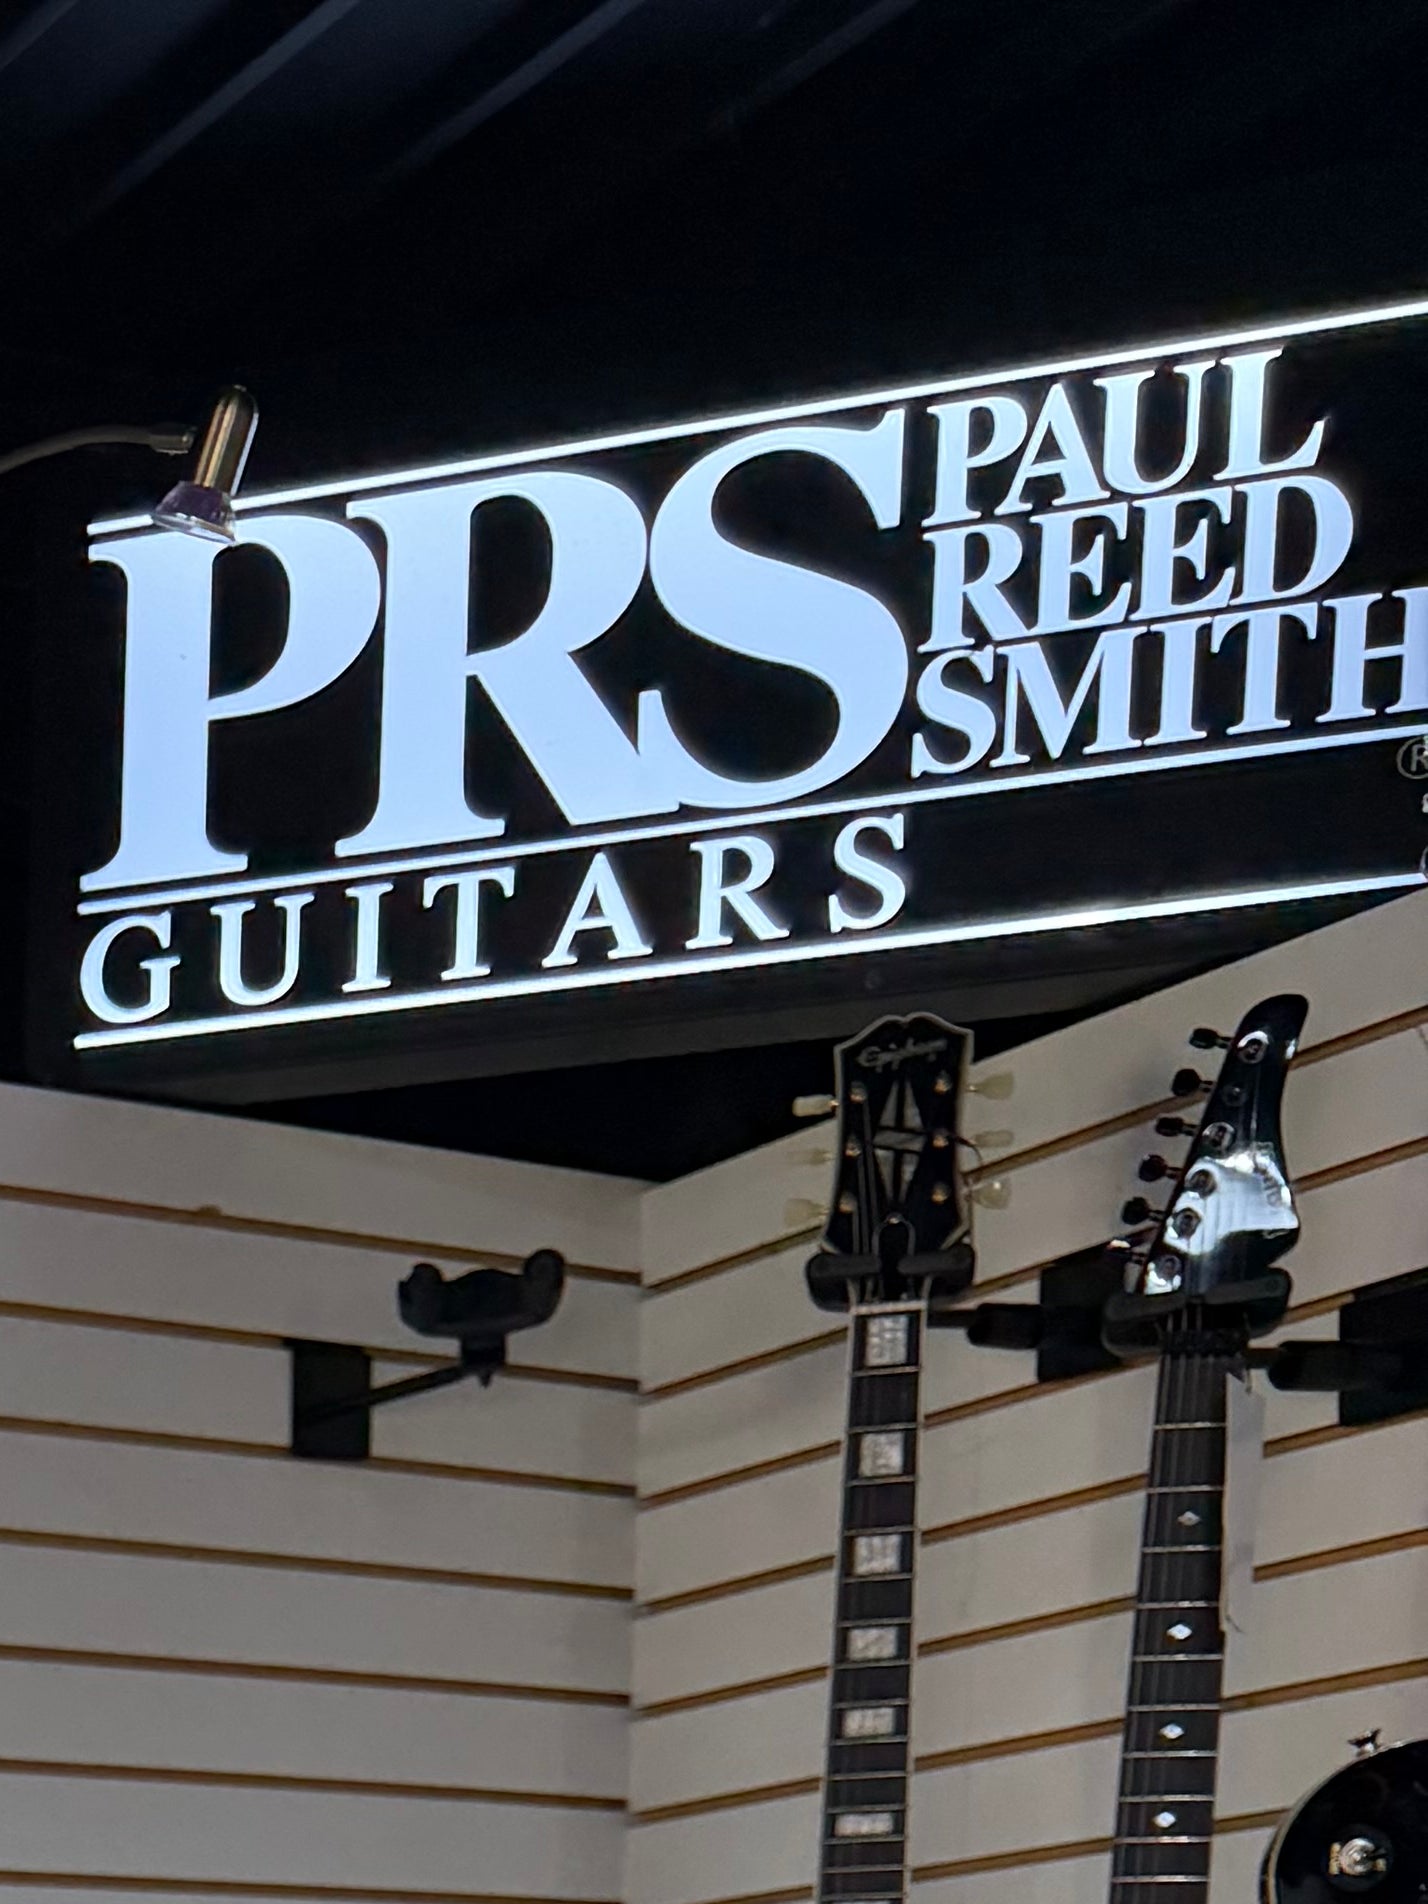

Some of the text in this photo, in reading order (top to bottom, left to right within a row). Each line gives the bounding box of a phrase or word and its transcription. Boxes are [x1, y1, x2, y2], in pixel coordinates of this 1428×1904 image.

[923, 348, 1327, 527] PAUL
[80, 409, 908, 892] PRS
[918, 474, 1354, 653] REED
[911, 585, 1428, 780] SMITH
[79, 811, 909, 1026] GUITARS
